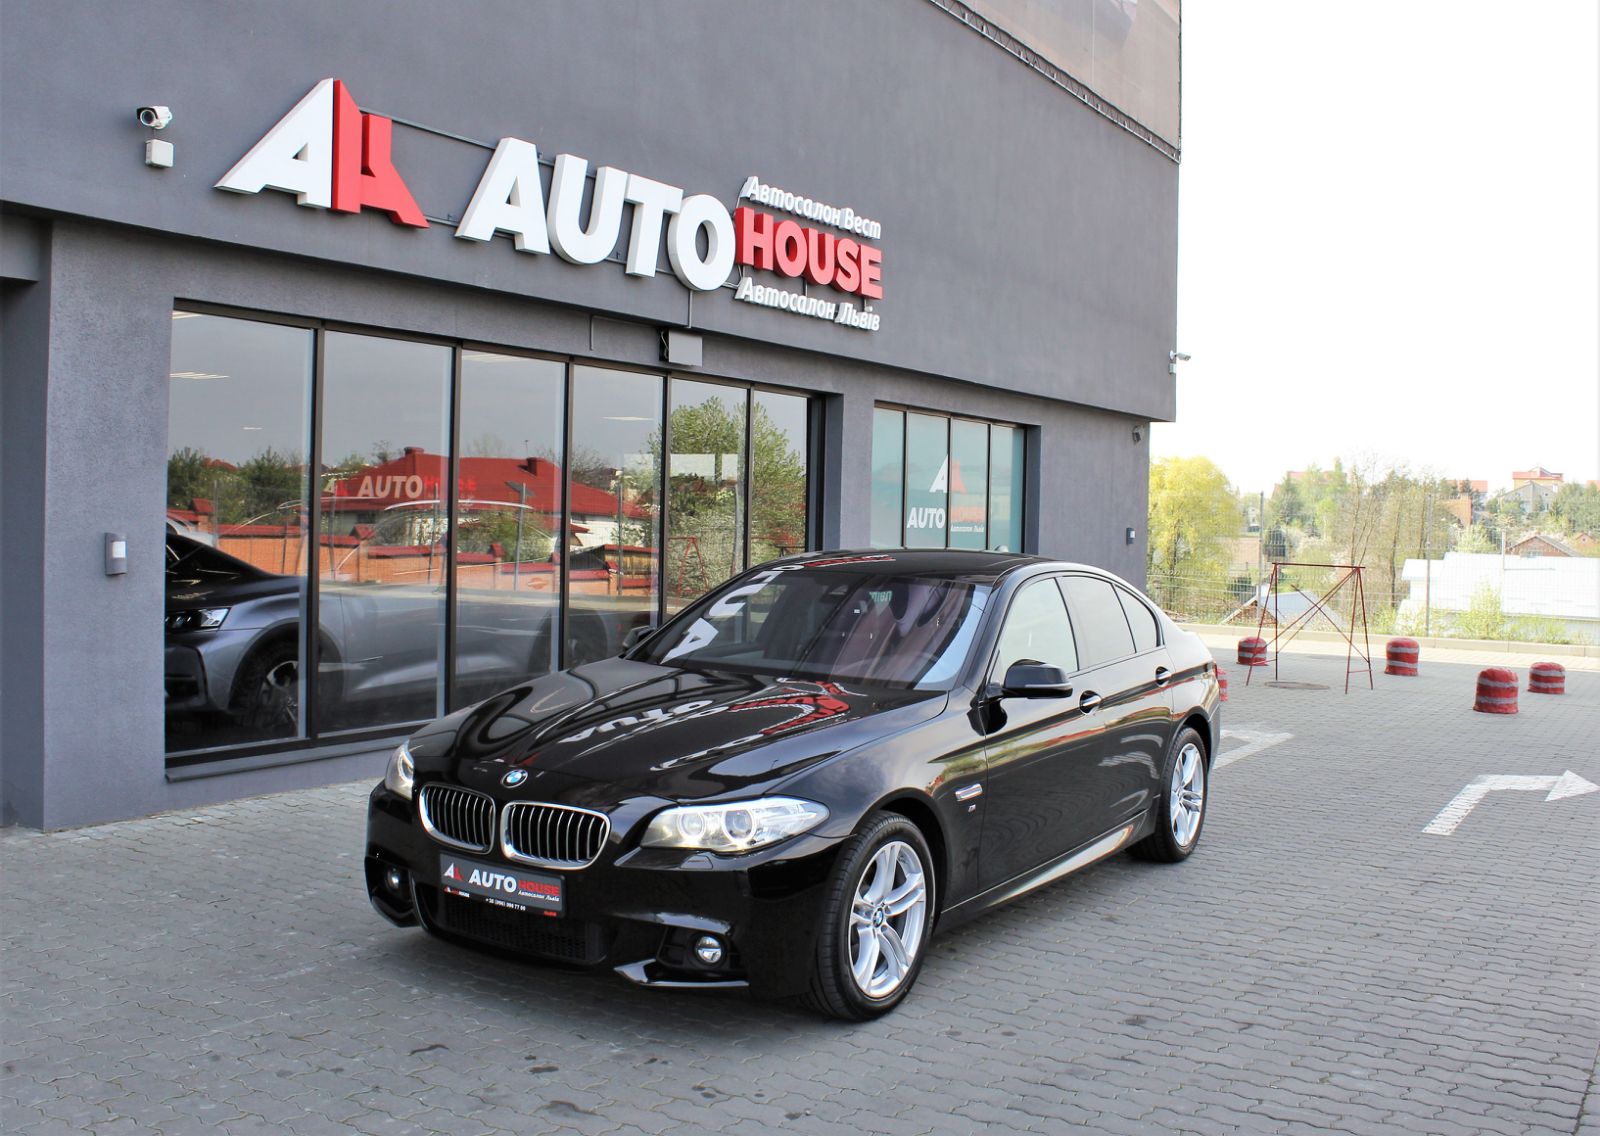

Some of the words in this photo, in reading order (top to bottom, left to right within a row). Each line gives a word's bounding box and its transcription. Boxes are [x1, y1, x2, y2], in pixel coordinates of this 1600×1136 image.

[455, 137, 736, 291] AUTO
[740, 176, 841, 227] Автосалон
[839, 207, 882, 240] Вест
[735, 207, 883, 300] HOUSE
[735, 276, 836, 320] Автосалон
[834, 302, 881, 331] Львів
[357, 475, 423, 499] AUTO
[906, 507, 946, 529] AUTO
[468, 869, 517, 893] AUTO
[518, 879, 560, 897] HOUSE
